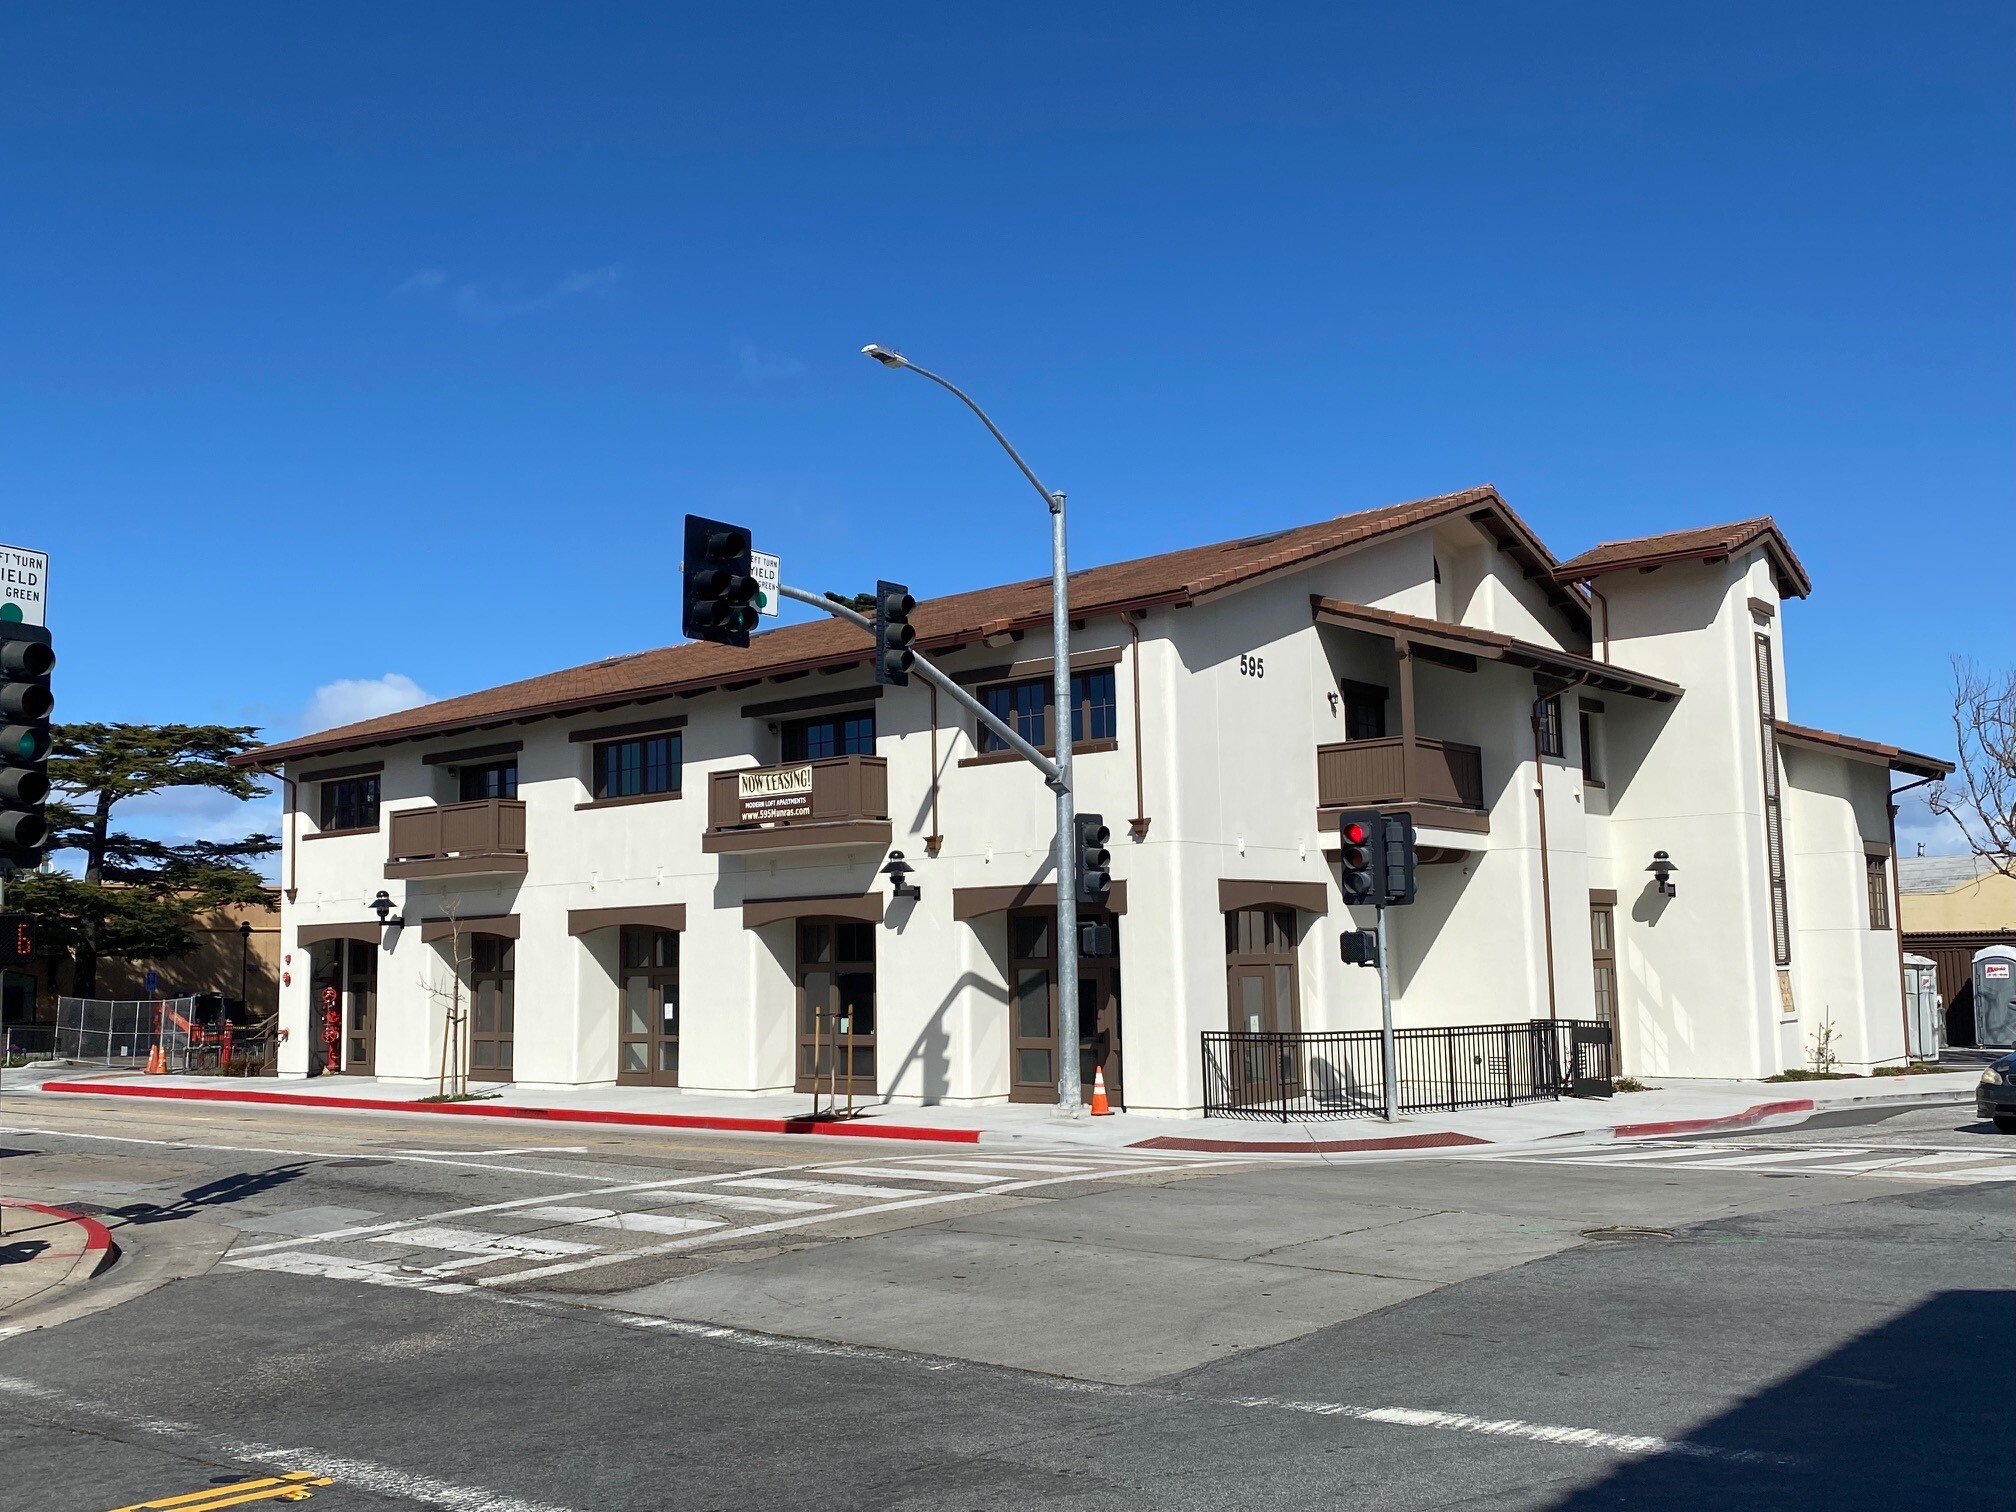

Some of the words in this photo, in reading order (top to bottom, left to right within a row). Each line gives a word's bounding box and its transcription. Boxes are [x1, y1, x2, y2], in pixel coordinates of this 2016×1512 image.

[16, 555, 42, 569] TURN
[764, 558, 777, 568] TURN
[1, 567, 38, 586] IELD
[751, 566, 775, 580] YIELD
[6, 586, 39, 602] GREEN
[1240, 654, 1264, 679] 595
[741, 775, 763, 793] NOW
[766, 769, 810, 790] LEASING!
[765, 799, 776, 807] LOFT
[776, 797, 806, 805] APARTMENTS
[742, 807, 810, 820] www.595Munras.com
[17, 923, 31, 954] 6
